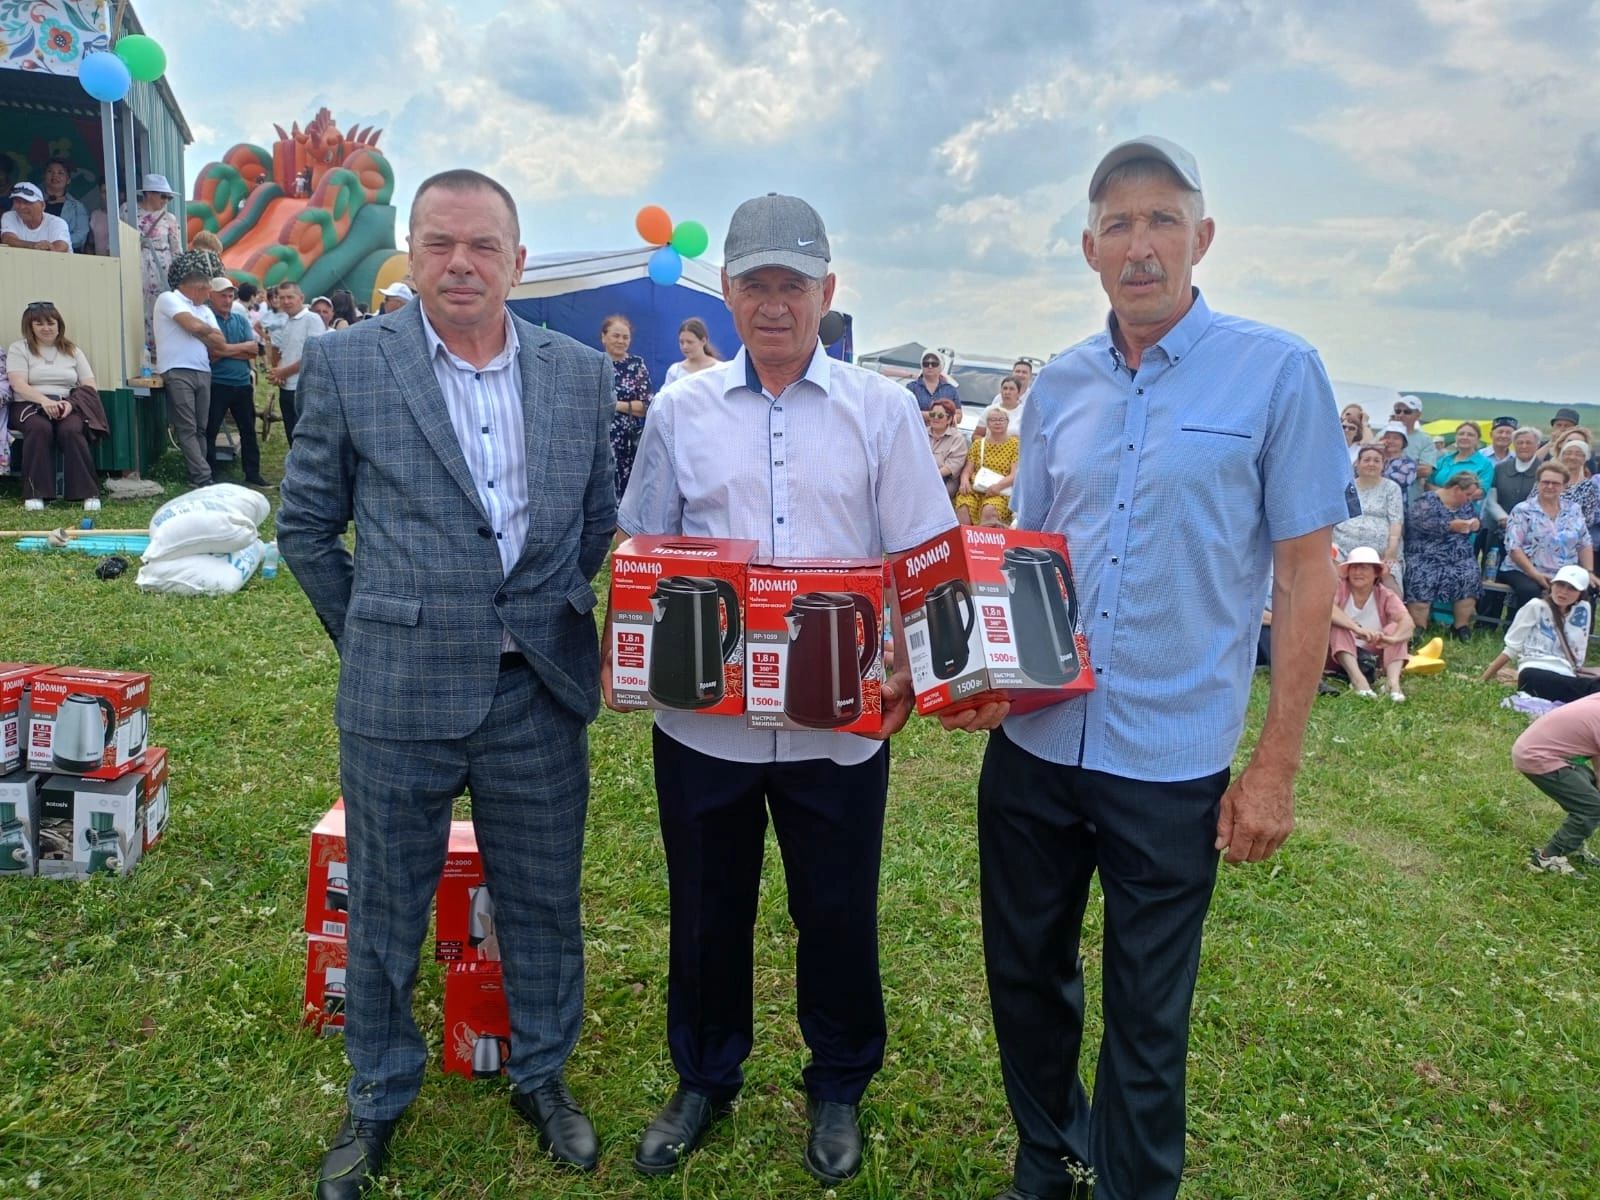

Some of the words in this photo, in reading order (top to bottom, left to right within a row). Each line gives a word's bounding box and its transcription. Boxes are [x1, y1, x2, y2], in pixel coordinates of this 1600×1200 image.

[965, 529, 1006, 549] Яромир
[905, 540, 951, 579] Яромир
[615, 558, 663, 579] Яромир
[749, 578, 798, 595] Яромир
[984, 607, 997, 617] 1,8
[621, 633, 634, 643] 1,8
[755, 654, 769, 663] 1,8
[989, 652, 1010, 662] 1500
[616, 675, 638, 686] 1500
[956, 679, 976, 694] 1500
[34, 682, 68, 696] Яромир
[751, 697, 774, 706] 1500
